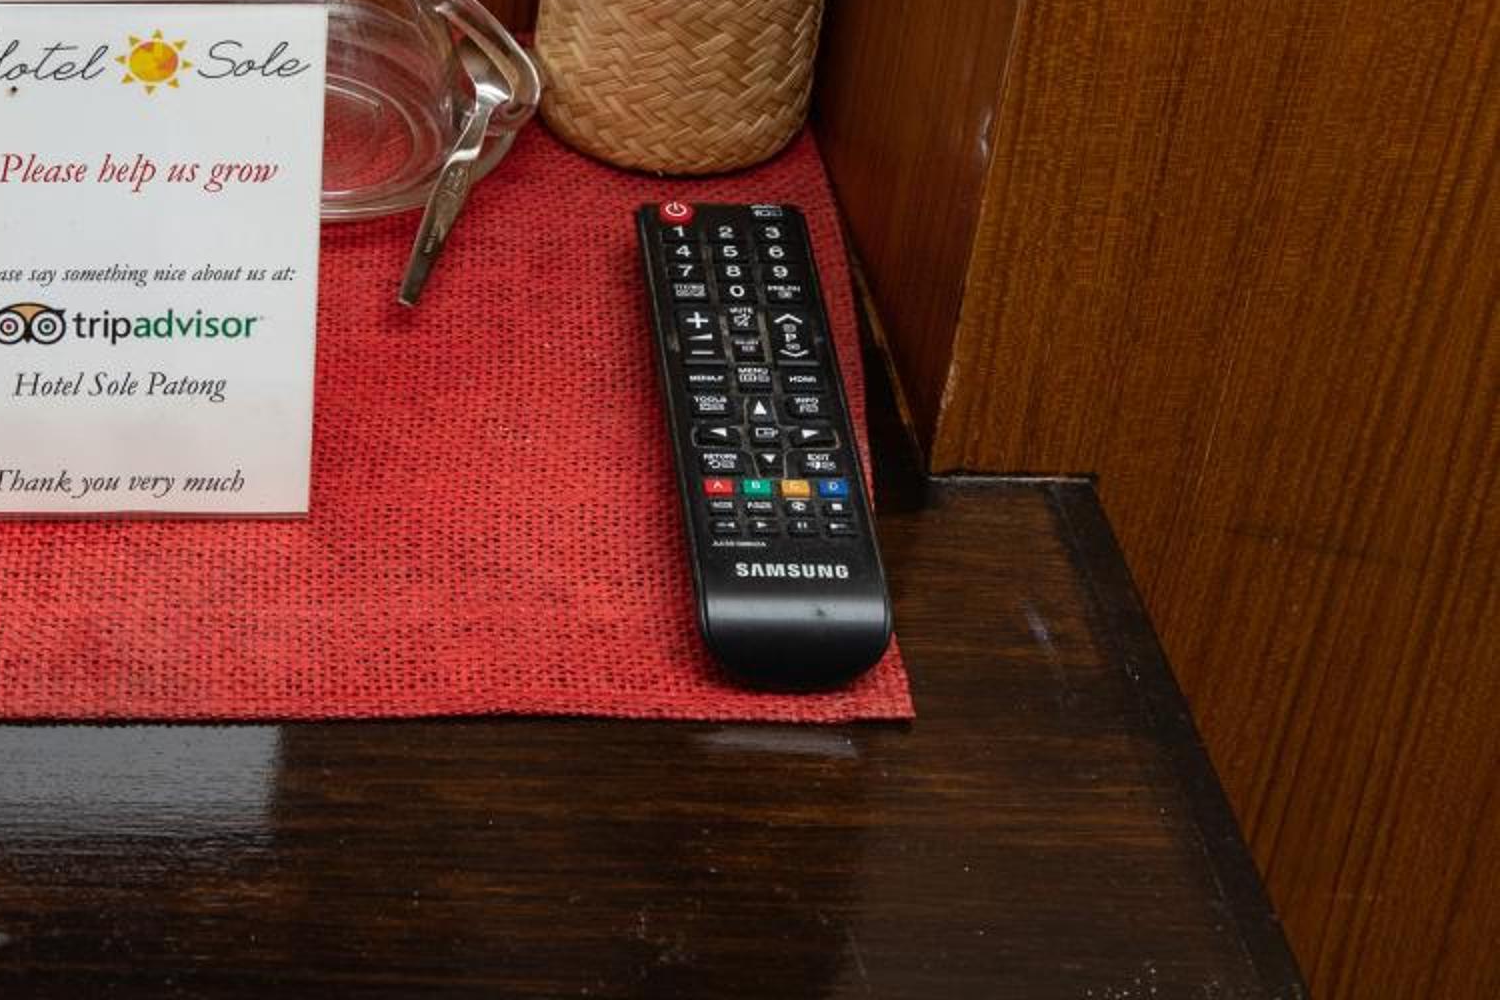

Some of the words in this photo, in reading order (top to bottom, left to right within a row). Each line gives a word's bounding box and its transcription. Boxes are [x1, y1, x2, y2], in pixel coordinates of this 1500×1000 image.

[198, 40, 312, 81] Sole
[98, 153, 157, 193] help
[167, 163, 200, 184] us
[204, 163, 278, 193] grow
[672, 225, 685, 238] 1
[718, 225, 734, 239] 2
[764, 226, 781, 239] 3
[675, 244, 692, 257] 4
[722, 245, 739, 257] 5
[768, 245, 785, 258] 6
[27, 268, 56, 287] say
[61, 263, 148, 287] something
[153, 264, 185, 282] nice
[191, 263, 241, 282] about
[246, 268, 265, 282] us
[271, 266, 296, 282] at:
[678, 264, 693, 277] 7
[725, 264, 742, 277] 8
[772, 265, 789, 279] 9
[729, 284, 745, 297] 0
[72, 308, 257, 345] tripadvisor
[12, 372, 84, 397] Hotel
[88, 371, 138, 397] Sole
[147, 371, 227, 403] Patong
[71, 475, 120, 499] you
[128, 474, 175, 499] very
[183, 469, 245, 492] much
[713, 480, 723, 489] A
[735, 562, 849, 579] SAMSUNG
